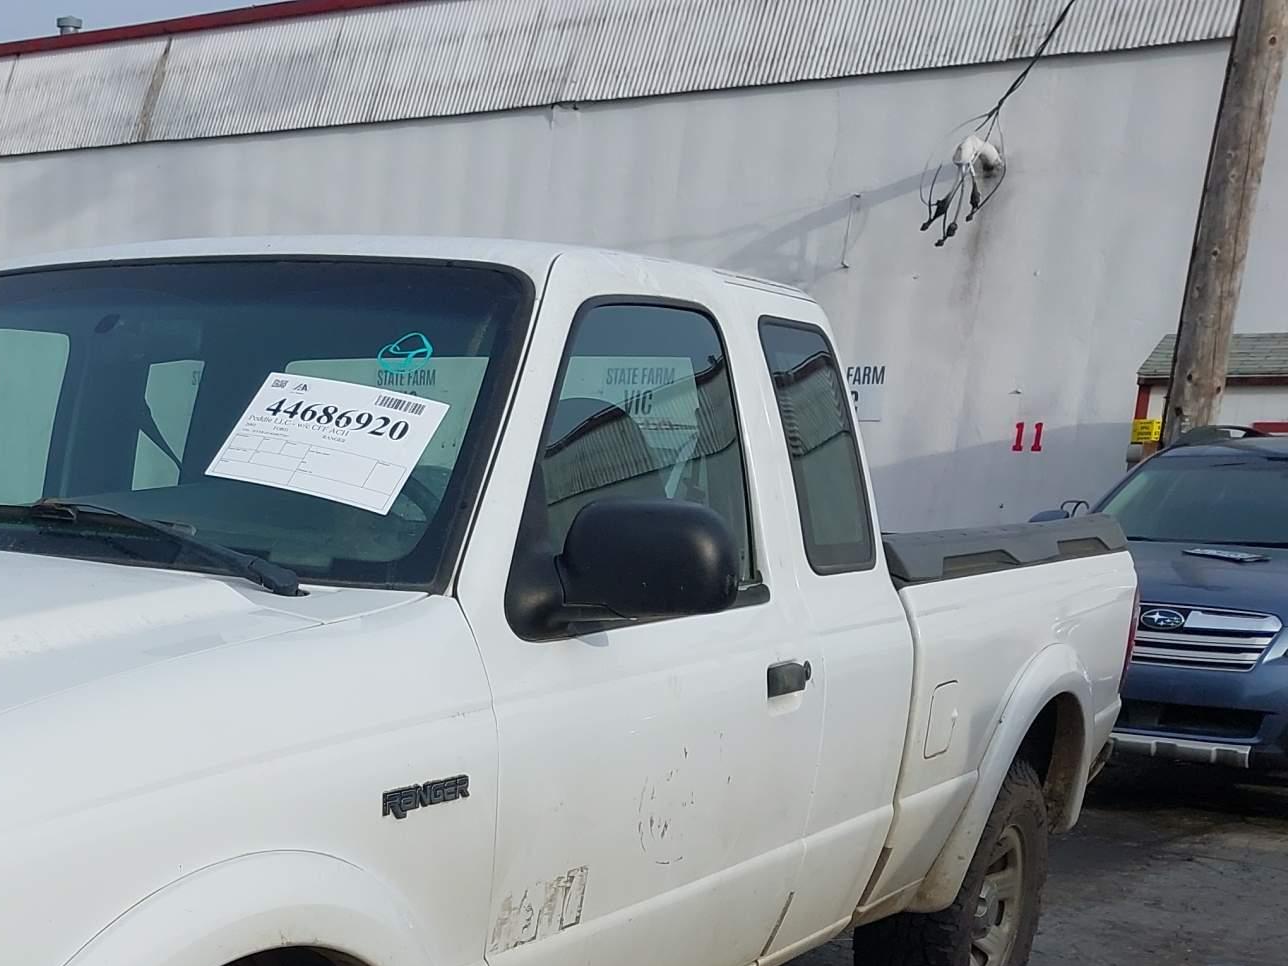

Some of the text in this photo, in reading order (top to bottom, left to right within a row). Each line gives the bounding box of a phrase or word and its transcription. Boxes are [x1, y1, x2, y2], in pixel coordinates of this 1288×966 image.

[377, 369, 436, 387] STATE FARM
[606, 367, 675, 385] STATE FARM
[846, 366, 885, 385] FARM
[624, 389, 653, 415] VIC
[265, 397, 409, 441] 44686920
[1012, 422, 1044, 451] 11
[382, 775, 470, 820] RANGER
